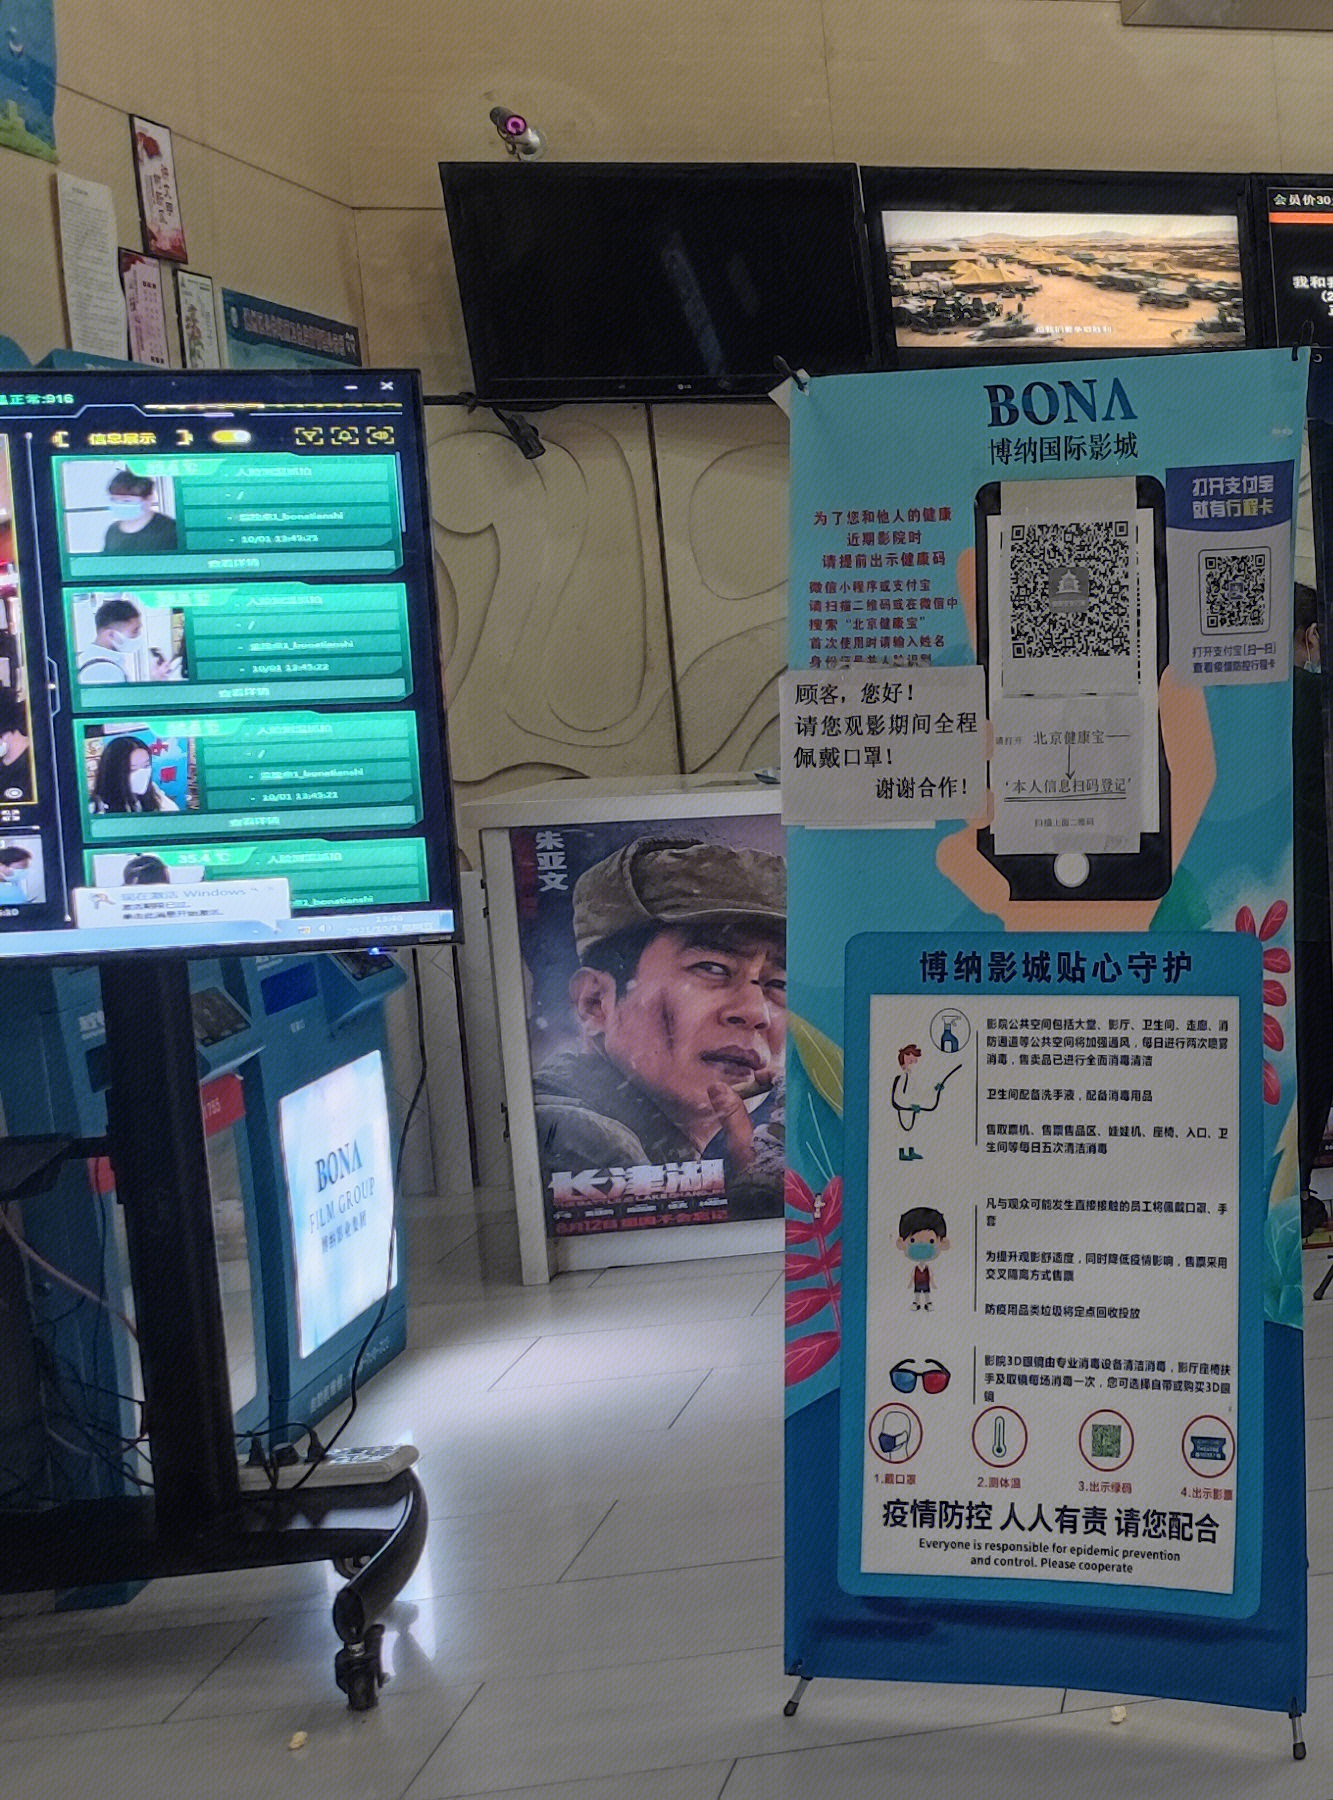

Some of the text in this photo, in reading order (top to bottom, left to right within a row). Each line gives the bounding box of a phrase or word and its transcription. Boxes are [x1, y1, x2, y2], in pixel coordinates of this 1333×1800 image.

[984, 378, 1137, 427] BONA
[988, 432, 1139, 466] 博纳国际影城
[1192, 475, 1274, 497] 打开支付宝
[813, 507, 952, 526] 为了您和他人的健康
[1192, 497, 1274, 520] 就有行程卡
[847, 530, 922, 546] 近期影院时
[821, 552, 946, 570] 请提前出示健康码
[809, 578, 931, 595] 微信小程序或支付宝
[809, 596, 959, 614] 请扫描二维码或在微信中
[809, 635, 945, 651] 首次使用时请输入姓名
[795, 712, 978, 737] 请您观影期间全程
[1033, 729, 1106, 746] 北京健康宝
[535, 831, 569, 892] 朱亚文
[183, 886, 246, 898] Windows
[919, 950, 1193, 985] 博纳影城贴心守护
[315, 1139, 363, 1193] BONA
[548, 1159, 725, 1204] 长津湖
[308, 1176, 376, 1235] FILM GROUP
[986, 1268, 1074, 1282] 交叉隔离方式售票
[986, 1304, 1141, 1319] 防疫用品类垃圾将定点回收投放
[882, 1500, 1220, 1543] 疫情防控 人人有责 请您配合
[919, 1537, 1180, 1562] Everyone is responsible for epidemic prevention
[971, 1555, 1133, 1574] and control. Please cooperate
